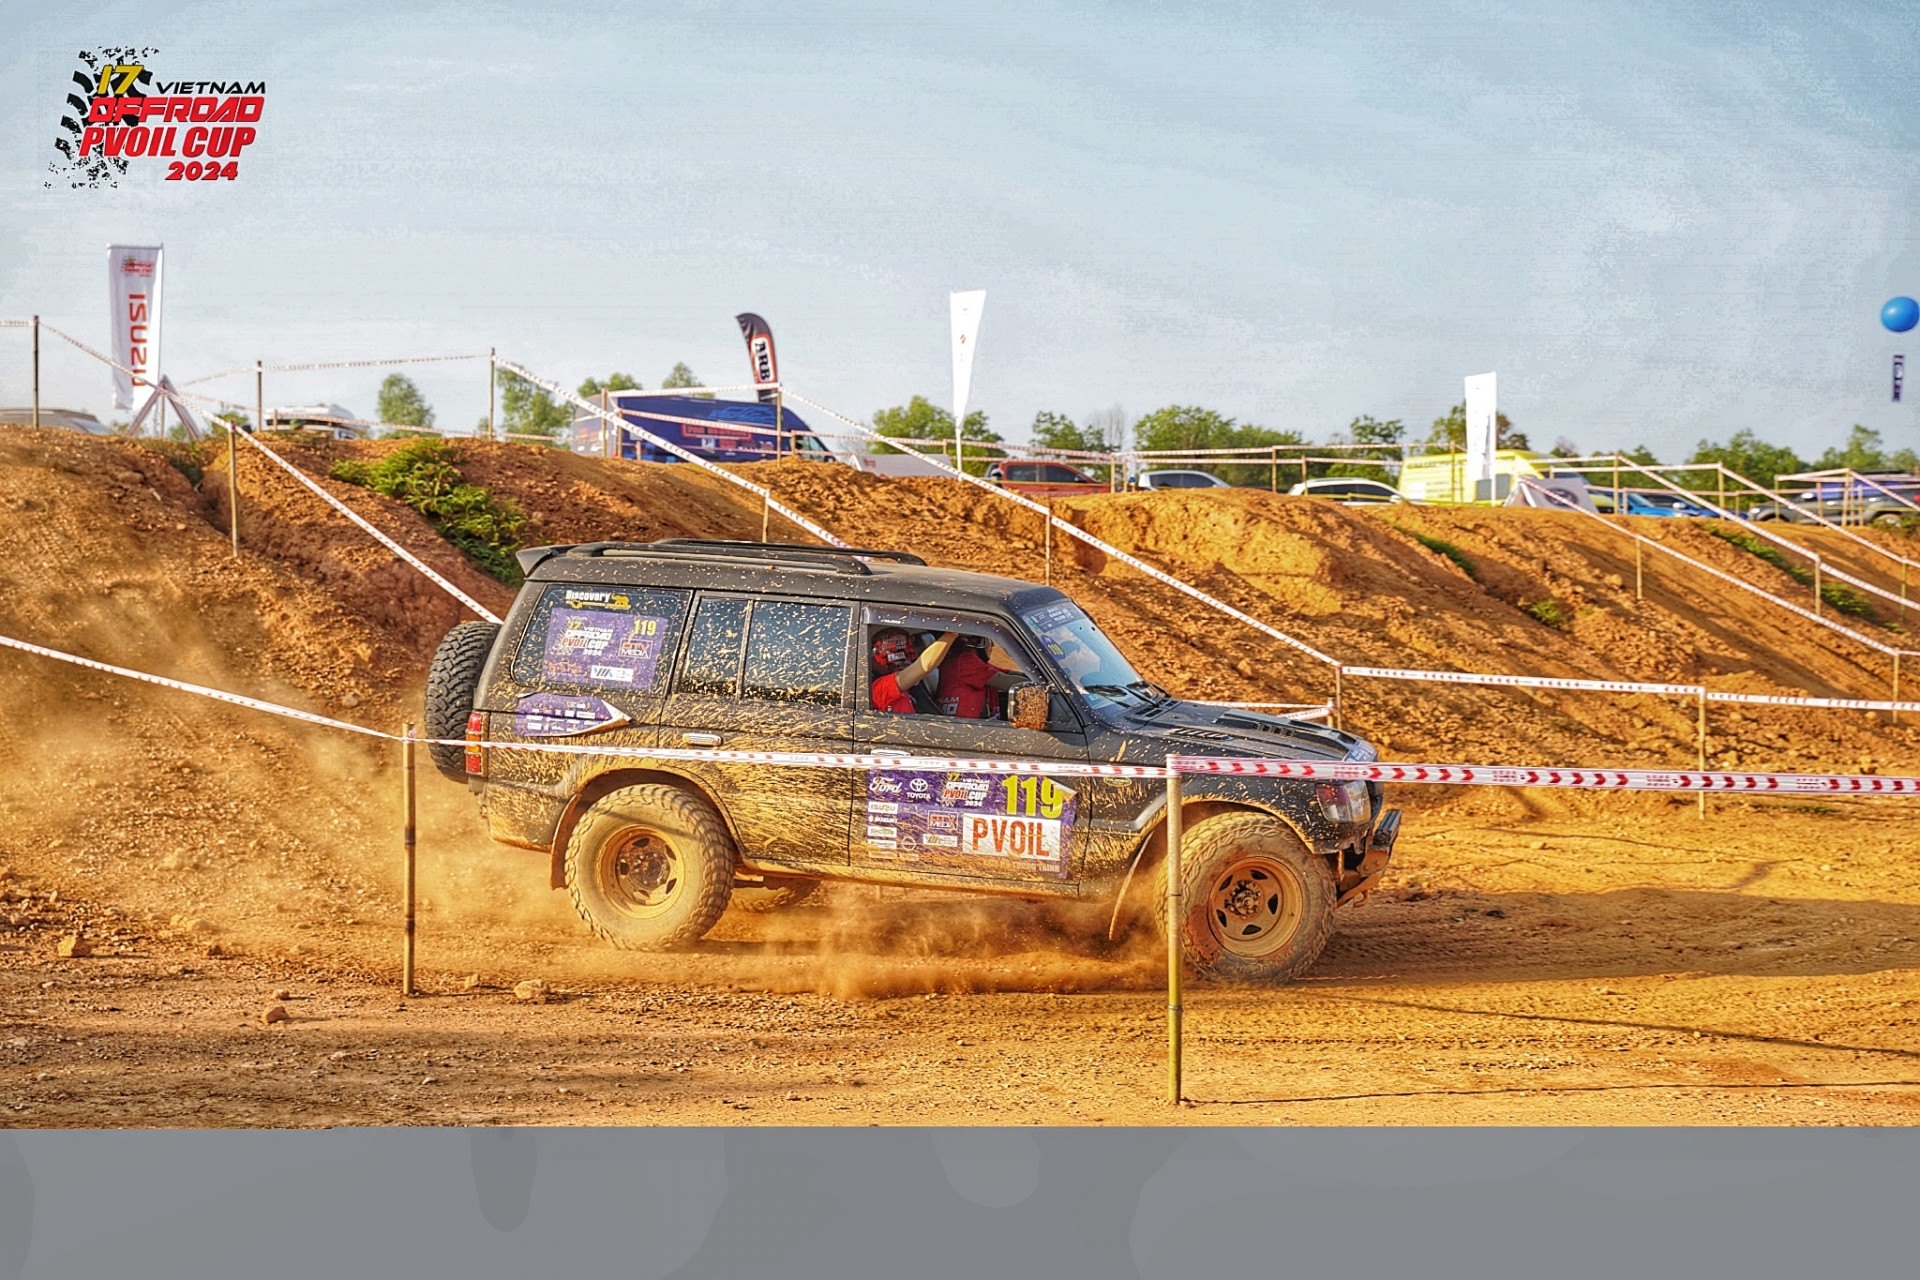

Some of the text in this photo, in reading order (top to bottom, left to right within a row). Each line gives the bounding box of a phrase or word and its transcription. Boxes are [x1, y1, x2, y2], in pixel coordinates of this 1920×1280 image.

[128, 293, 148, 387] ISUZU
[755, 341, 771, 380] ARB
[633, 619, 657, 636] 119
[562, 637, 609, 650] PVOIL CUP
[621, 649, 649, 658] MEDIA
[868, 776, 903, 793] Ford
[946, 782, 990, 791] OFFROAD
[906, 792, 931, 800] TOYOTA
[943, 790, 987, 801] PVOIL CUP
[1002, 775, 1063, 819] 119
[929, 821, 956, 830] MEDIA
[972, 818, 1050, 857] PVOIL
